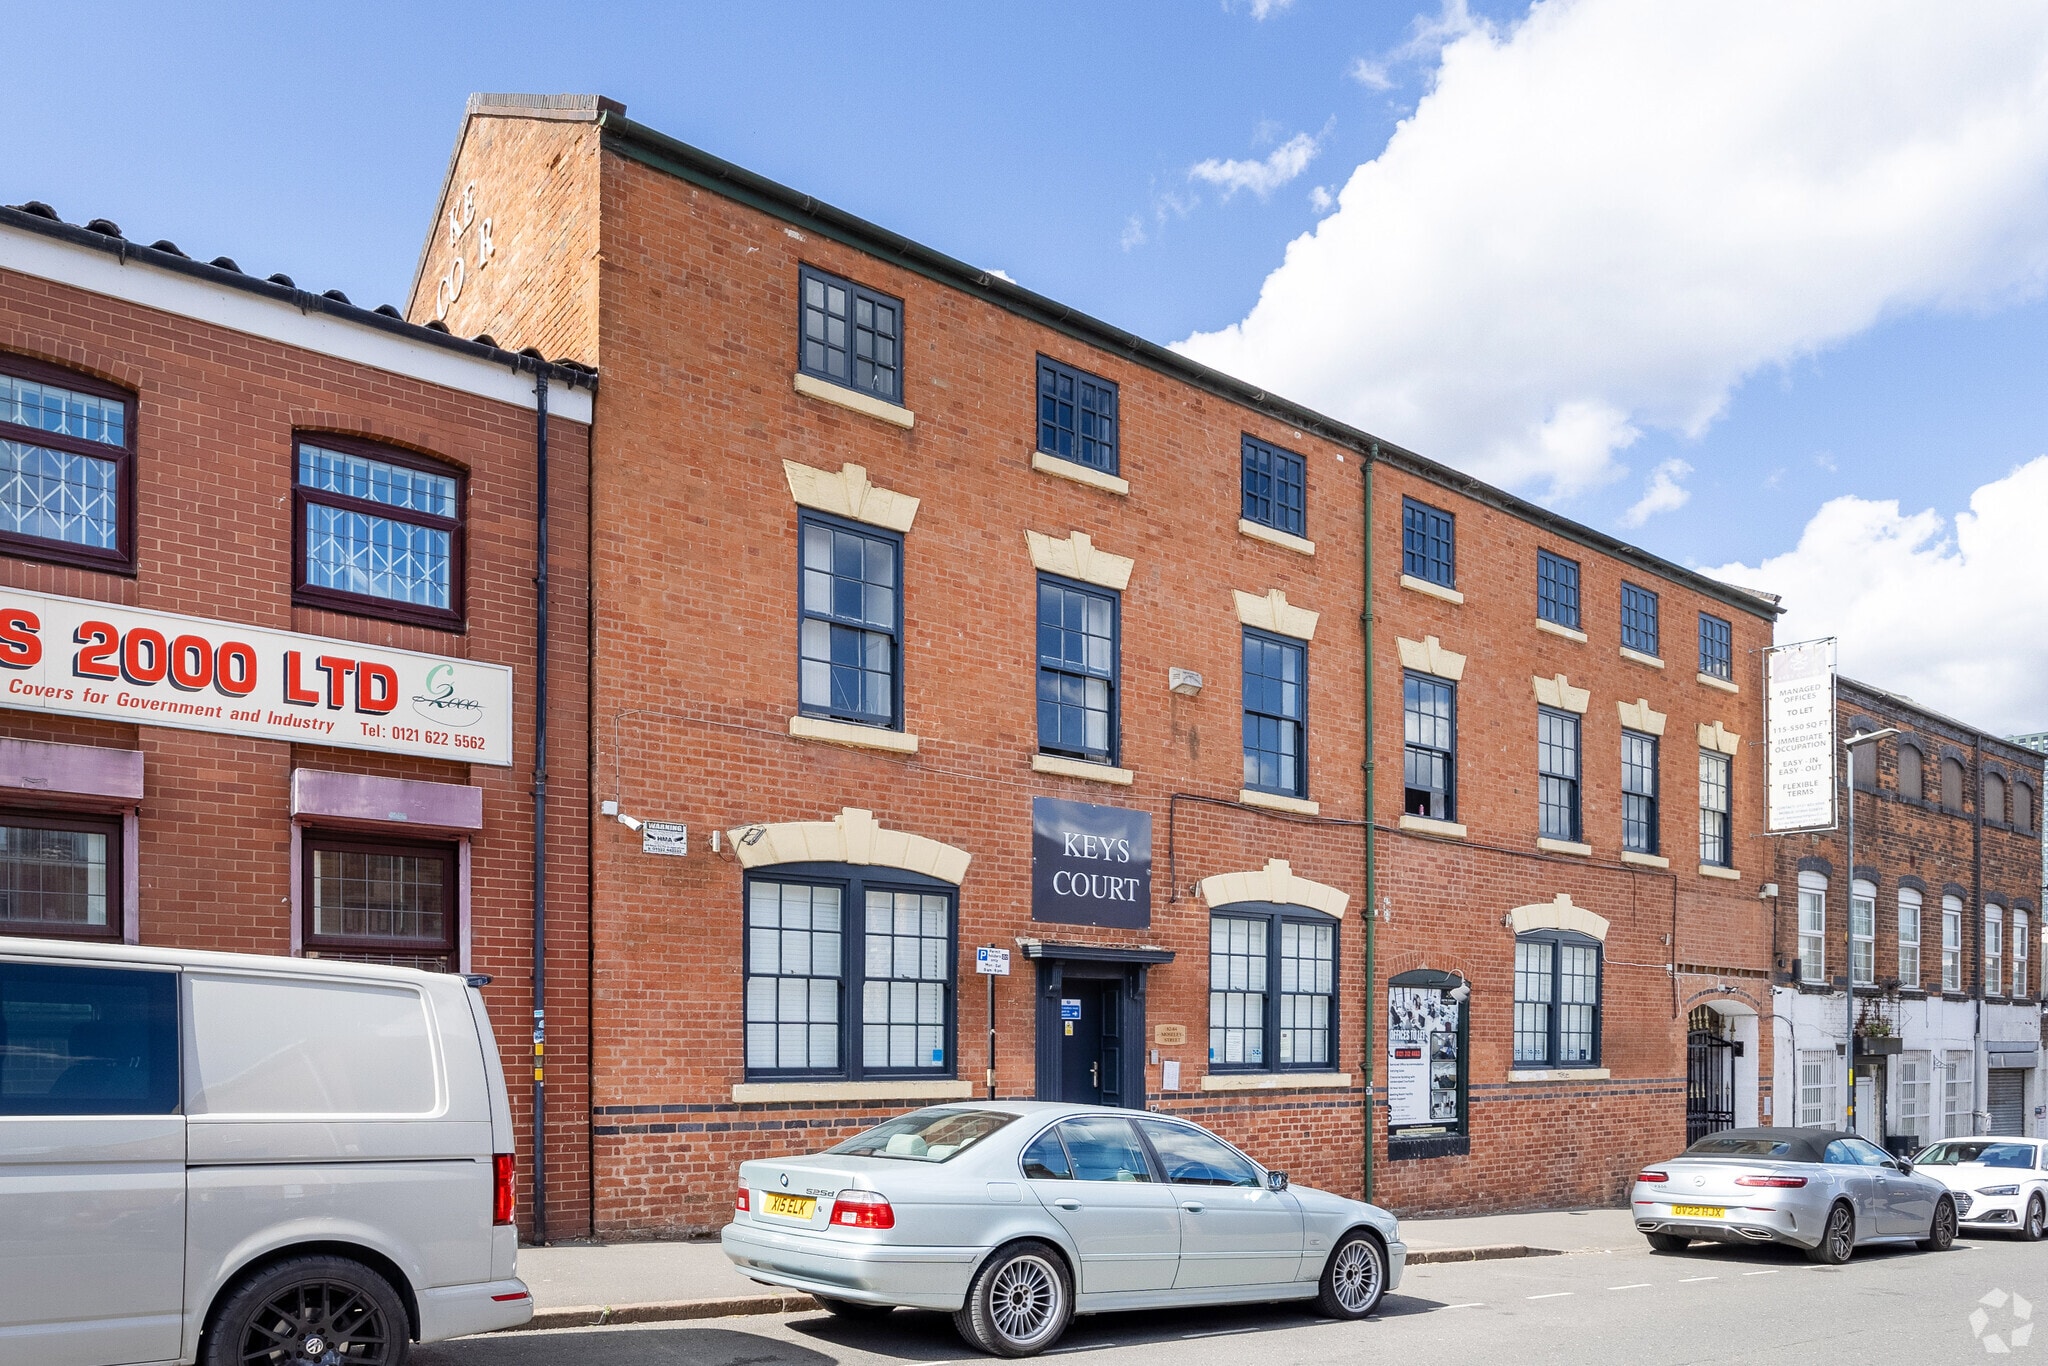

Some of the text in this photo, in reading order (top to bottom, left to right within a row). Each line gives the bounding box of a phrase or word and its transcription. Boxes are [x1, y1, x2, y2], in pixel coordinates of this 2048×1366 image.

[73, 620, 257, 698] 2000
[283, 650, 398, 716] LTD
[1779, 684, 1821, 696] MANAGED
[1783, 692, 1817, 703] OFFICES
[9, 678, 335, 734] Covers for Government and Industry
[1799, 706, 1814, 715] LET
[1806, 721, 1817, 729] SQ
[361, 722, 486, 751] Tel: 0121 622 5562
[1778, 733, 1823, 745] IMMEDIATE
[1774, 740, 1827, 753] OCCUPATION
[1783, 759, 1803, 767] EASY
[1779, 767, 1799, 776] EASY
[1805, 764, 1822, 772] OUT
[1782, 780, 1819, 790] FLEXIBLE
[1787, 788, 1814, 797] TERMS
[648, 823, 682, 831] WARNING
[1063, 832, 1130, 864] KEYS
[1053, 870, 1140, 902] COURT
[1390, 1029, 1425, 1041] OFFICES TO LET
[805, 1188, 836, 1197] 525d
[771, 1197, 807, 1216] X15 ELK
